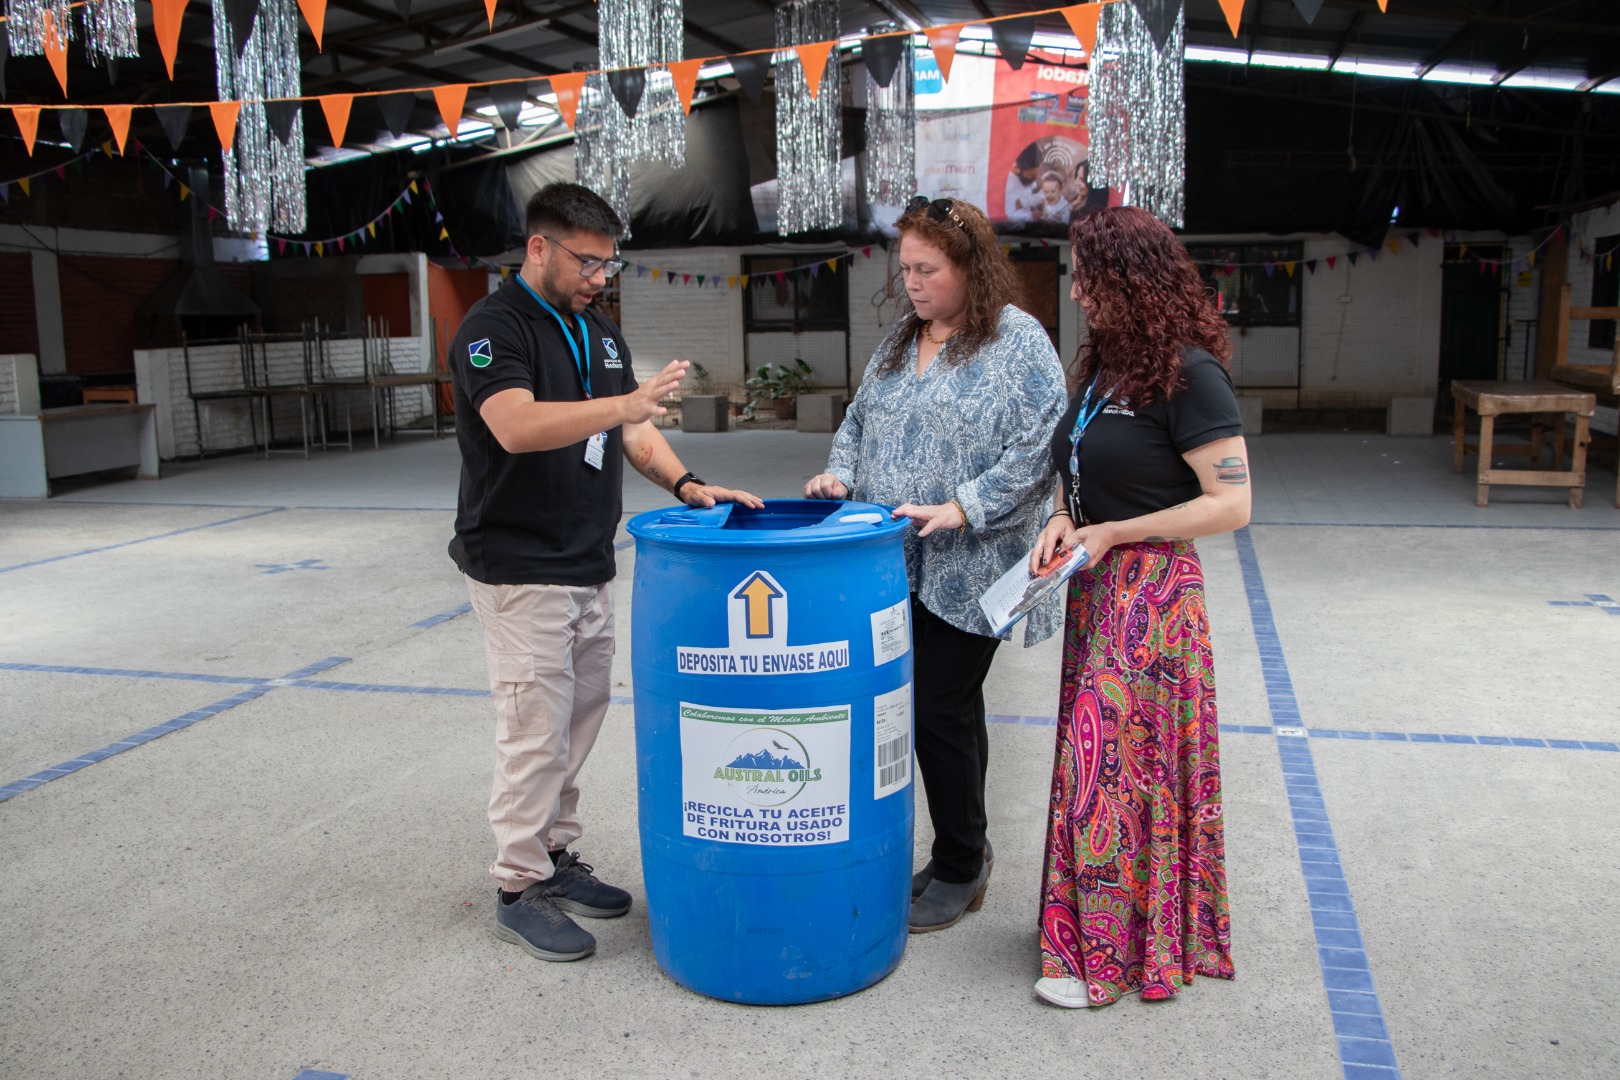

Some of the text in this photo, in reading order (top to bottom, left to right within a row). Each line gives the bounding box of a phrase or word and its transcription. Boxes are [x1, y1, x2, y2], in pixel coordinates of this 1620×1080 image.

[679, 648, 848, 673] DEPOSITA TU ENVASE AQUI
[682, 708, 736, 722] Colaboremos
[756, 715, 765, 723] el
[768, 714, 801, 723] Medio
[803, 712, 846, 723] Ambiente
[713, 767, 822, 782] AUSTRAL OILS
[745, 784, 787, 795] América
[683, 800, 846, 819] ¡RECICLA TU ACEITE
[687, 812, 843, 831] DE FRITURA USADO
[697, 827, 831, 843] CON NOSOTROS!
